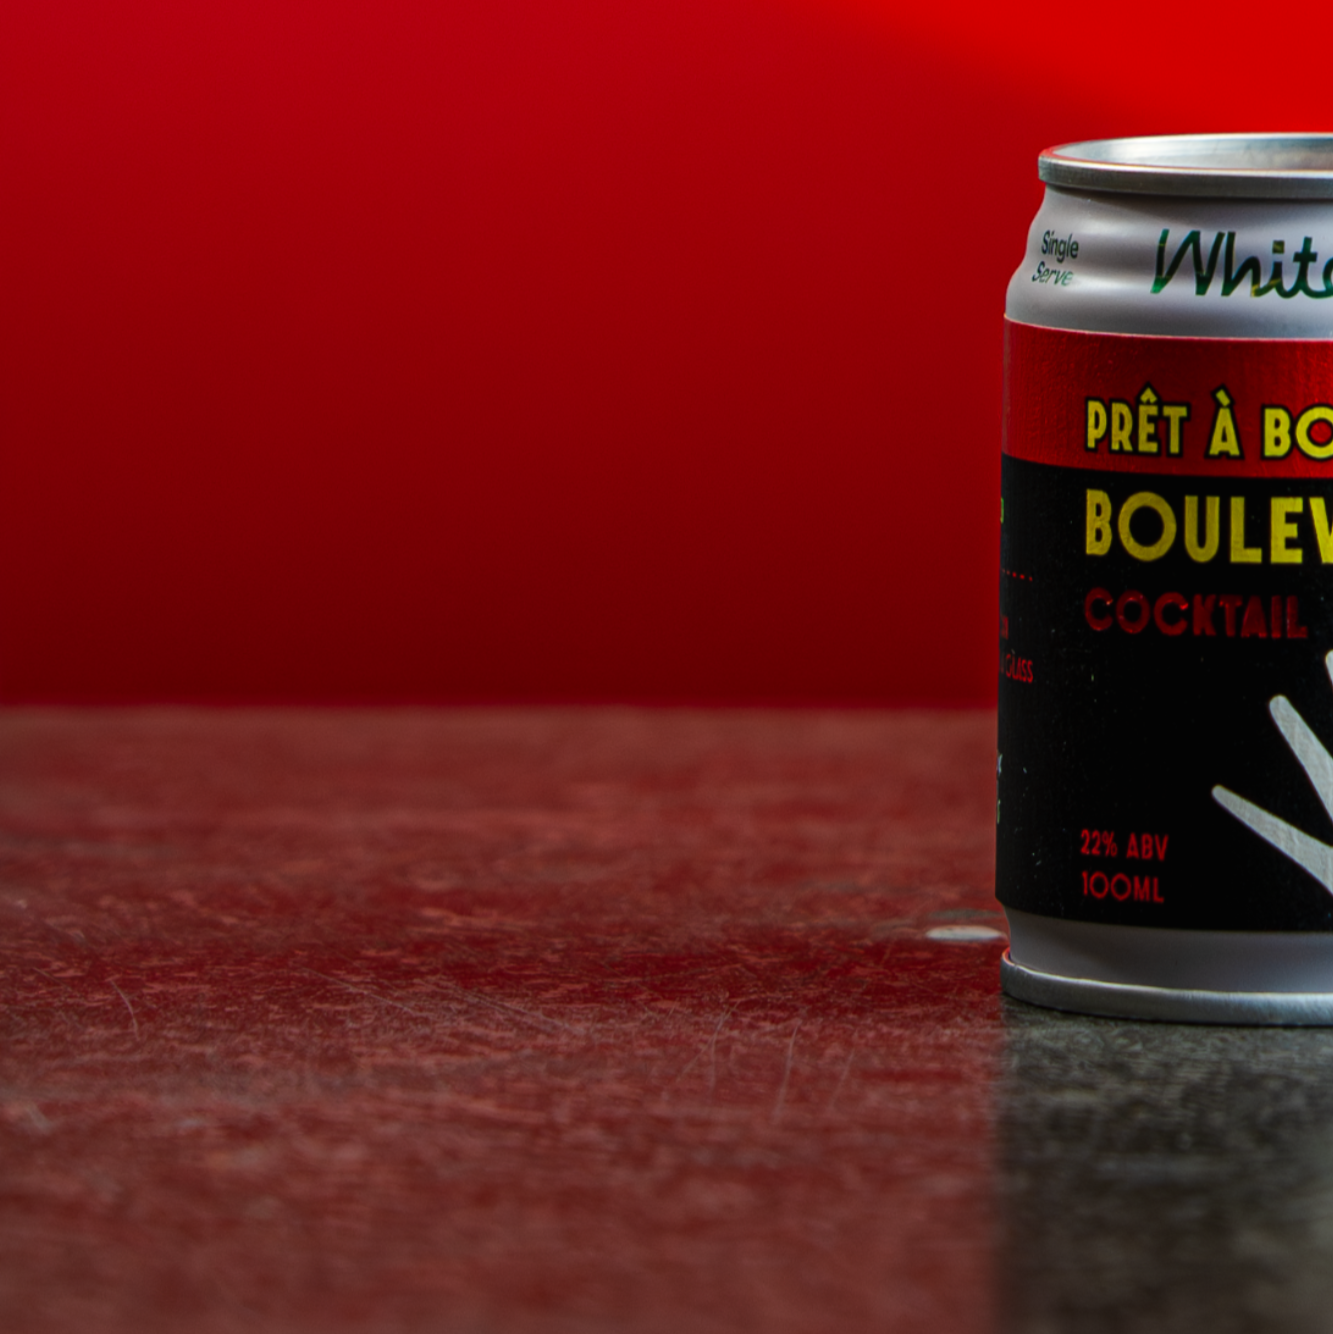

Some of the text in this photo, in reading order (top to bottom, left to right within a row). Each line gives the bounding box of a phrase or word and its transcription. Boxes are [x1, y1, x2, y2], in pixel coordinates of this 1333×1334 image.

[1041, 229, 1079, 264] Single
[1031, 260, 1074, 286] Serve
[1086, 384, 1190, 457] PRÊT
[1206, 385, 1243, 459] À
[1084, 587, 1308, 639] COCKTAIL
[1081, 829, 1168, 861] 22% ABV
[1082, 870, 1164, 904] 100ML
